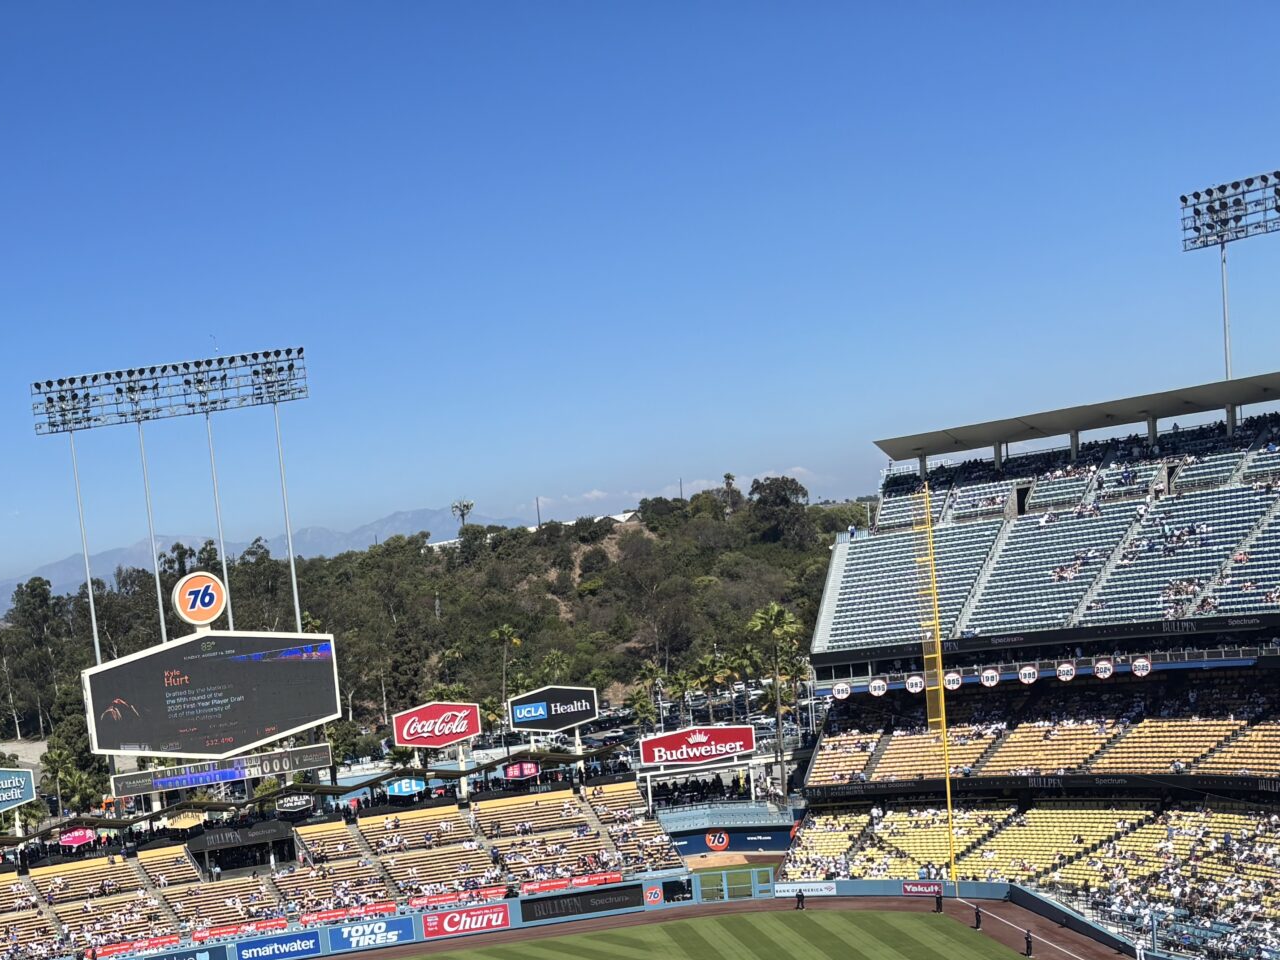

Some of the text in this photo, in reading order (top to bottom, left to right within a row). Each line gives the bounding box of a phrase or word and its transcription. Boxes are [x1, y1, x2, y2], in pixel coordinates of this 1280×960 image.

[186, 584, 216, 610] 76
[1162, 621, 1197, 632] BULLPEN
[164, 669, 180, 679] Kyle
[1095, 666, 1111, 674] 2024
[164, 675, 189, 687] Hurt
[517, 700, 590, 718] UCLA Health
[403, 709, 470, 740] Coca-Cola
[653, 741, 744, 762] Budweiser
[263, 758, 289, 773] 0 0 0
[393, 778, 418, 793] TEL
[709, 832, 725, 845] 76
[647, 889, 660, 900] 76
[904, 884, 941, 893] Yakult
[533, 894, 625, 917] BULLPEN Spectrum
[443, 910, 504, 932] Churu
[342, 922, 386, 938] TOYO
[349, 931, 398, 948] TIRES
[241, 938, 315, 959] smartwater
